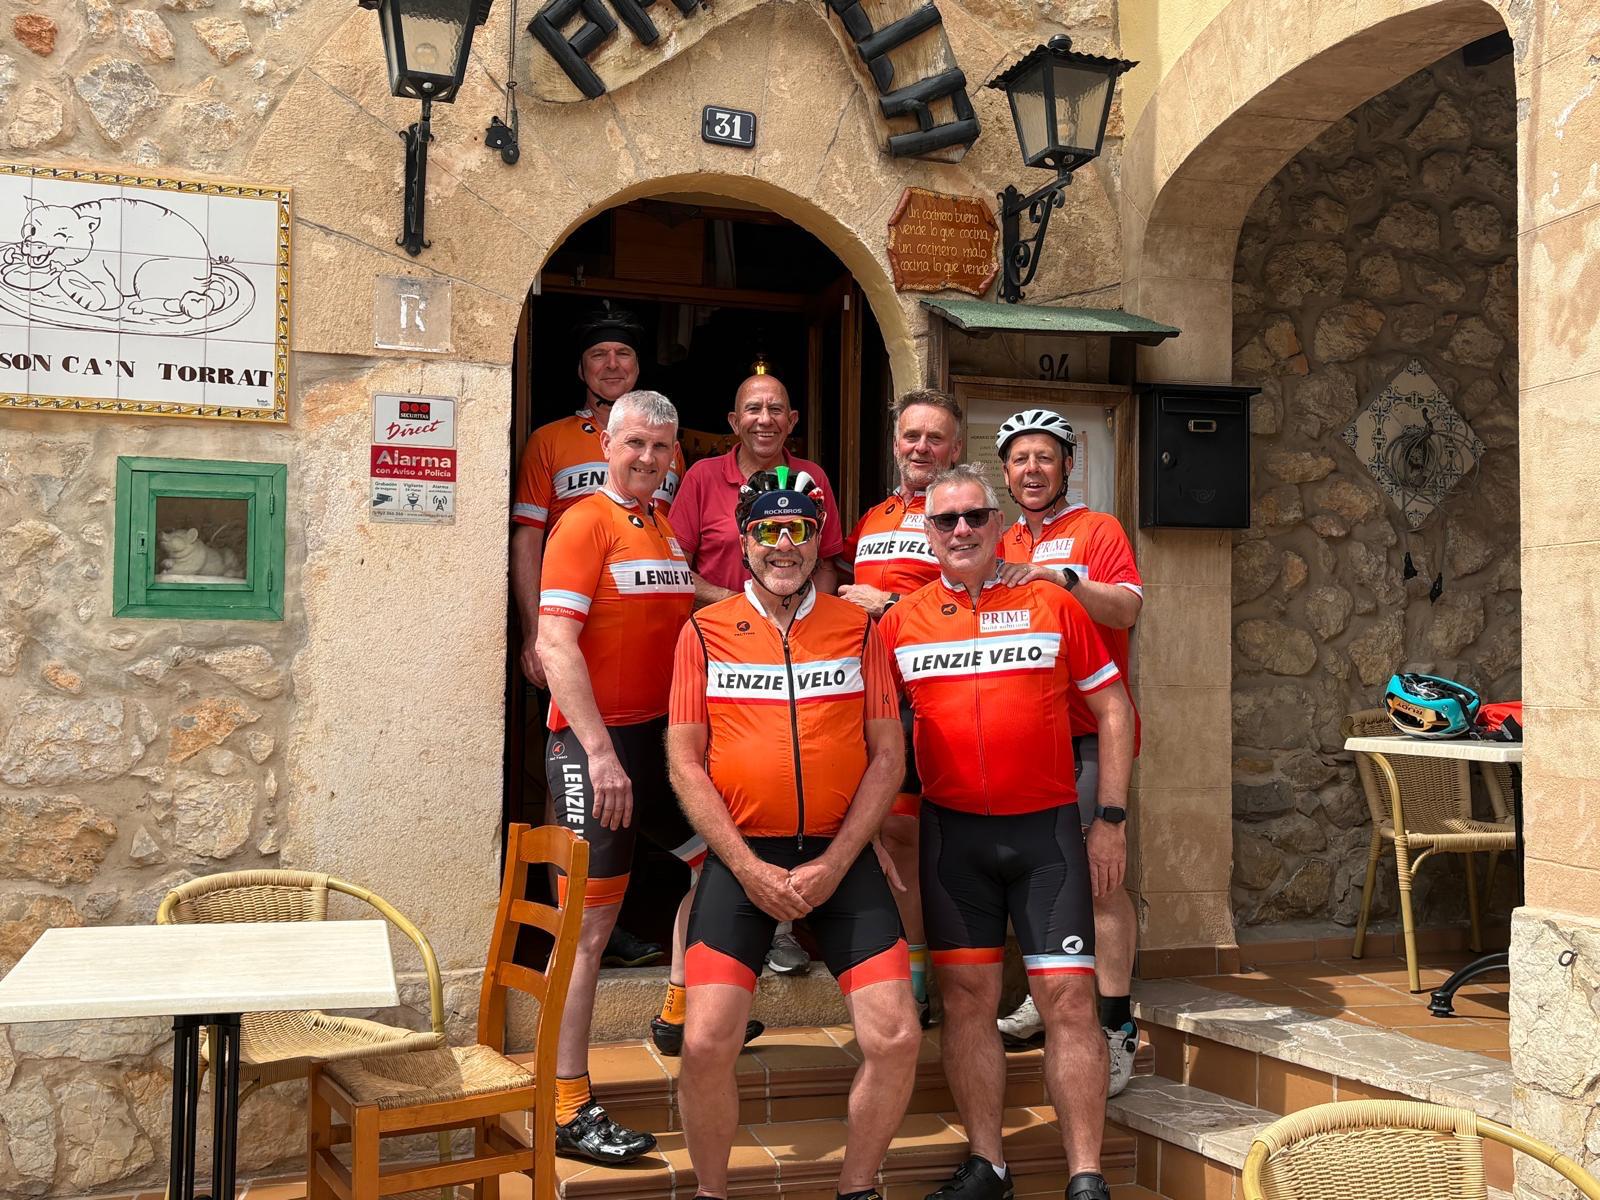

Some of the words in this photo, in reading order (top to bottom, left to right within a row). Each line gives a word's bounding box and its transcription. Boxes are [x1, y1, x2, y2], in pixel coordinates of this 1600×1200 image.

[714, 112, 742, 140] 31
[907, 203, 920, 219] Un
[922, 208, 953, 222] cocinero
[955, 208, 979, 224] bueno
[899, 220, 927, 236] vende
[930, 221, 938, 236] lo
[940, 227, 955, 243] que
[898, 243, 912, 254] un
[916, 242, 958, 256] cocinero
[962, 242, 987, 259] malo
[900, 260, 930, 272] cocina
[933, 257, 941, 272] lo
[943, 264, 959, 280] que
[962, 262, 990, 275] vende
[158, 362, 273, 387] TORRAT
[1039, 353, 1070, 381] 94
[386, 419, 446, 440] Direct
[377, 450, 452, 468] Alarma
[393, 467, 416, 475] Aviso
[567, 471, 608, 490] LEN
[858, 541, 897, 557] ENZIE
[1035, 540, 1073, 554] PRIME
[634, 570, 680, 586] LENZIE
[543, 607, 575, 616] PACTIMO
[981, 611, 1029, 624] PRIME
[912, 650, 983, 672] LENZIE
[989, 646, 1042, 665] VELO
[717, 673, 784, 691] LENZIE
[797, 669, 846, 690] VELO
[562, 764, 585, 825] LENZIE
